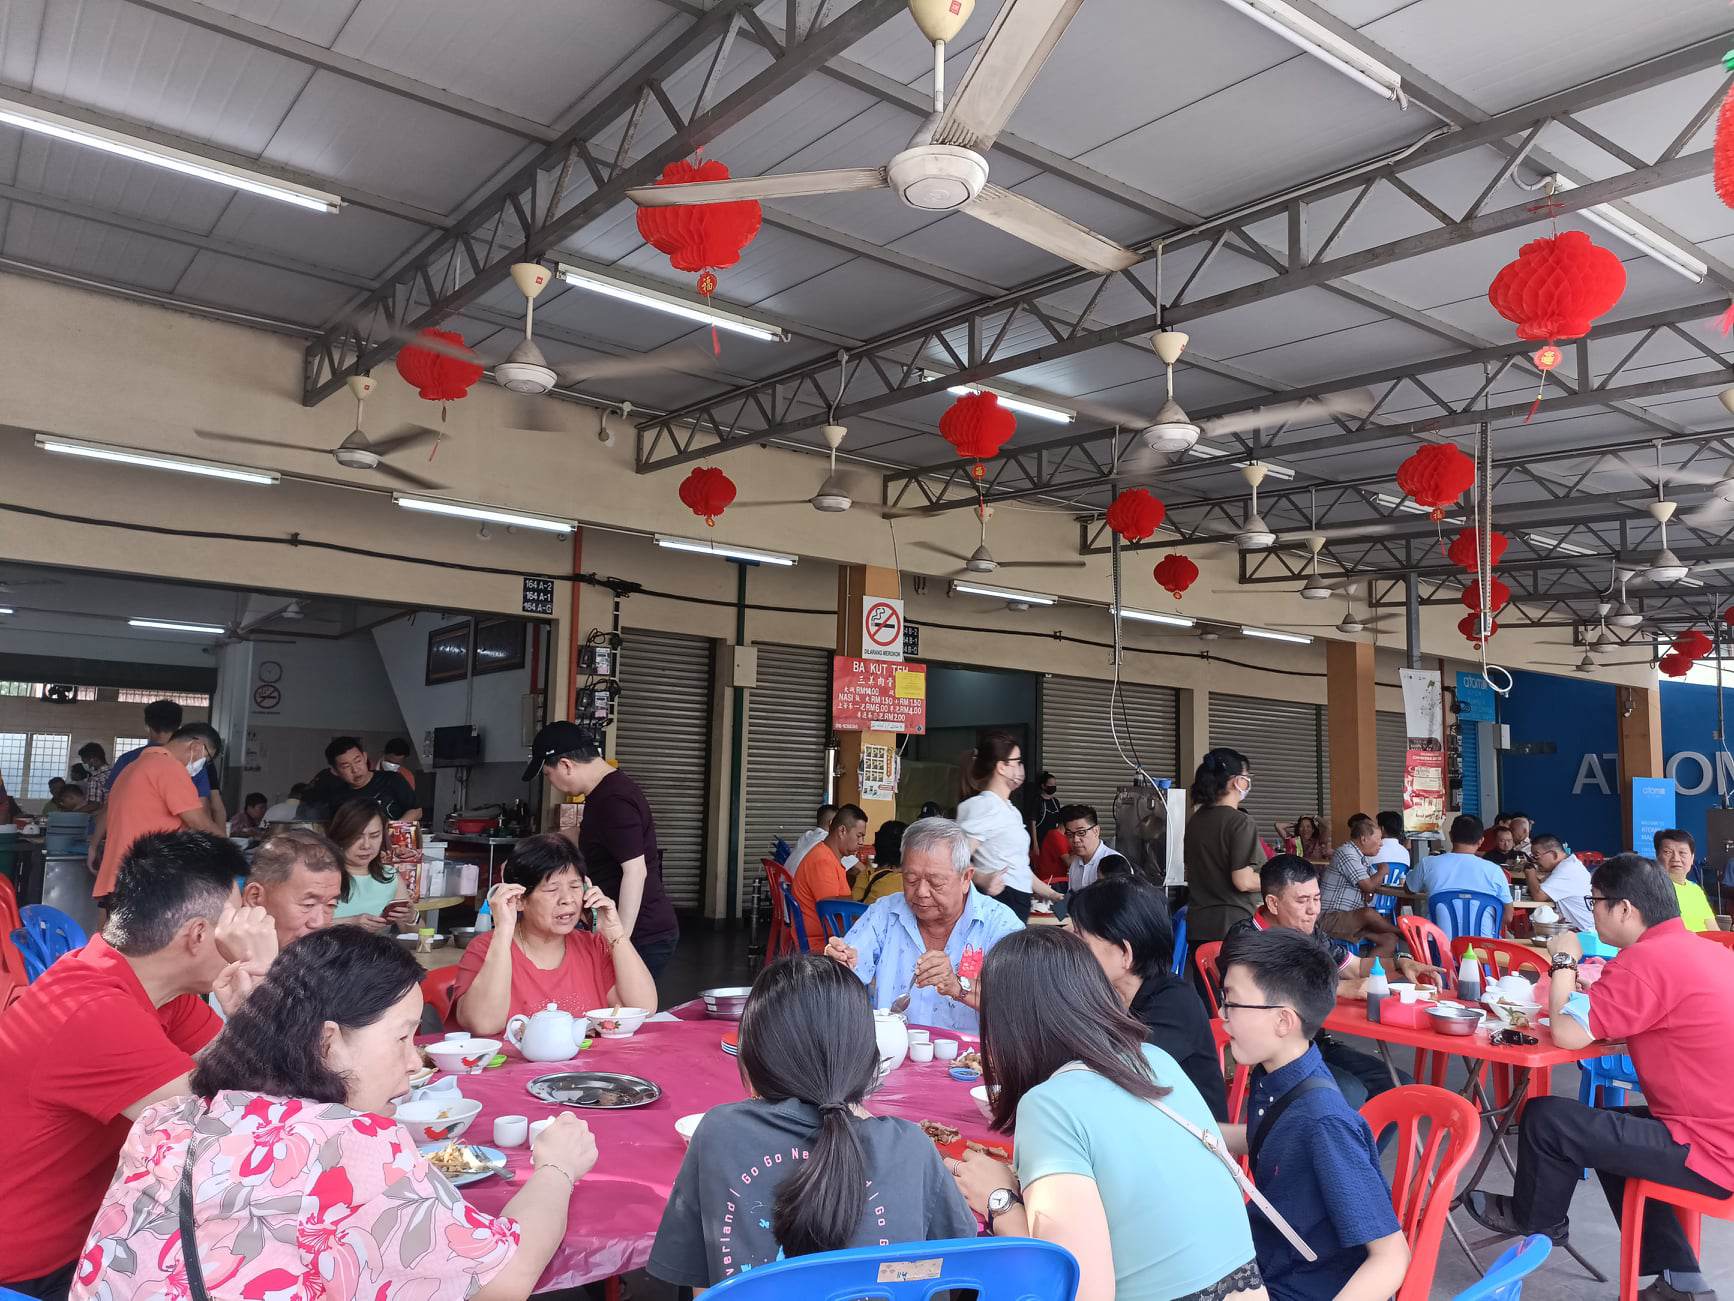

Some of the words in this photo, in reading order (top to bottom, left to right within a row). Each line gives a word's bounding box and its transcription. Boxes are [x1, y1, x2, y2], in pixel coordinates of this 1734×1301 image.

[701, 275, 713, 292] 福
[526, 580, 537, 588] 164
[539, 581, 552, 591] A-2
[526, 591, 538, 600] 164
[539, 592, 551, 602] A-1
[524, 602, 536, 611] 164
[537, 603, 552, 613] A-G
[853, 661, 865, 673] BA
[870, 663, 888, 675] KUT
[838, 692, 854, 702] NASI
[741, 1166, 759, 1185] Go
[763, 1153, 782, 1168] Go
[791, 1148, 810, 1160] Ne
[875, 1206, 886, 1227] Go
